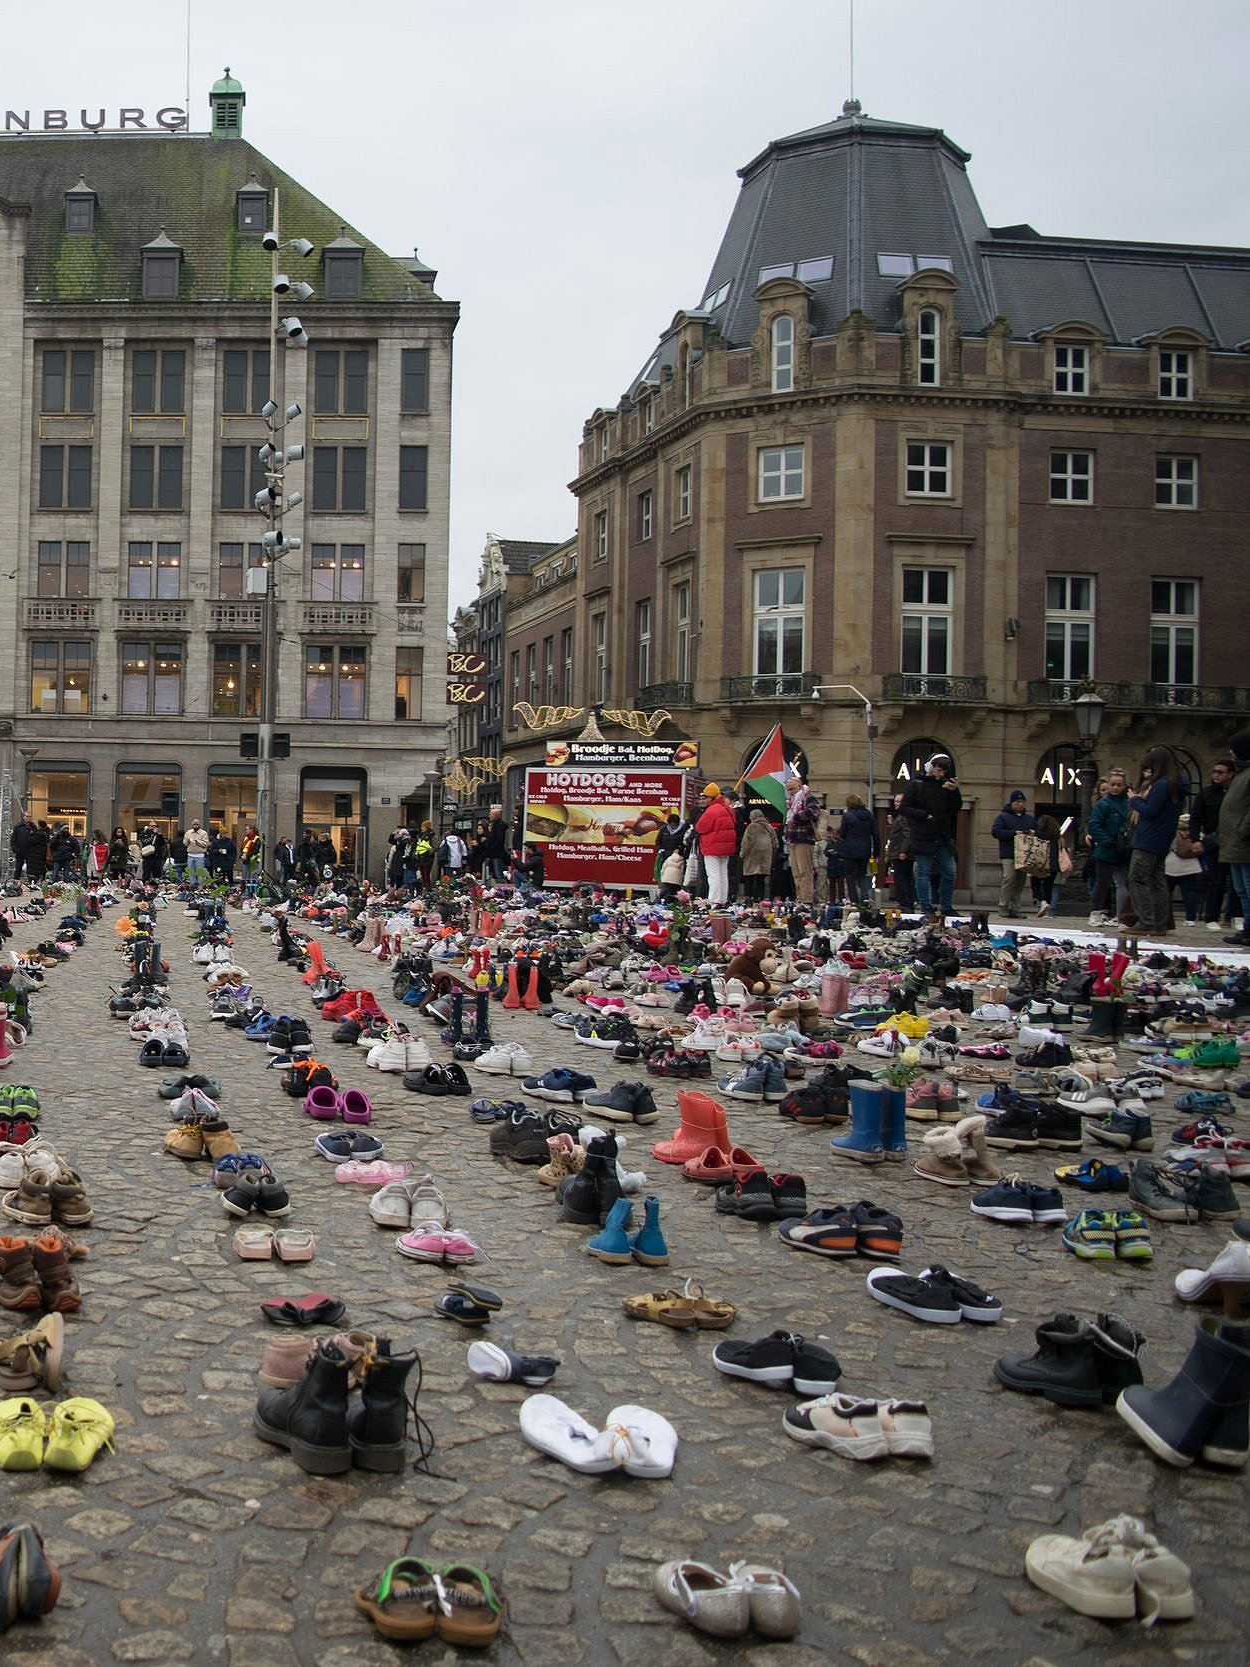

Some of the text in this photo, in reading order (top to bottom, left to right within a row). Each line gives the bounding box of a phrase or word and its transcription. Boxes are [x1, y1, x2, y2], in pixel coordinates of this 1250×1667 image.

[447, 653, 486, 674] P&C
[447, 683, 486, 703] P&C
[571, 744, 616, 755] Broodje
[629, 754, 670, 763] Beenham
[546, 773, 627, 787] HOTDOGS
[568, 786, 596, 796] Broodje
[636, 788, 669, 796] Beenham
[612, 845, 635, 853] Grilled
[636, 846, 654, 854] Ham
[598, 853, 643, 862] Ham/Cheese
